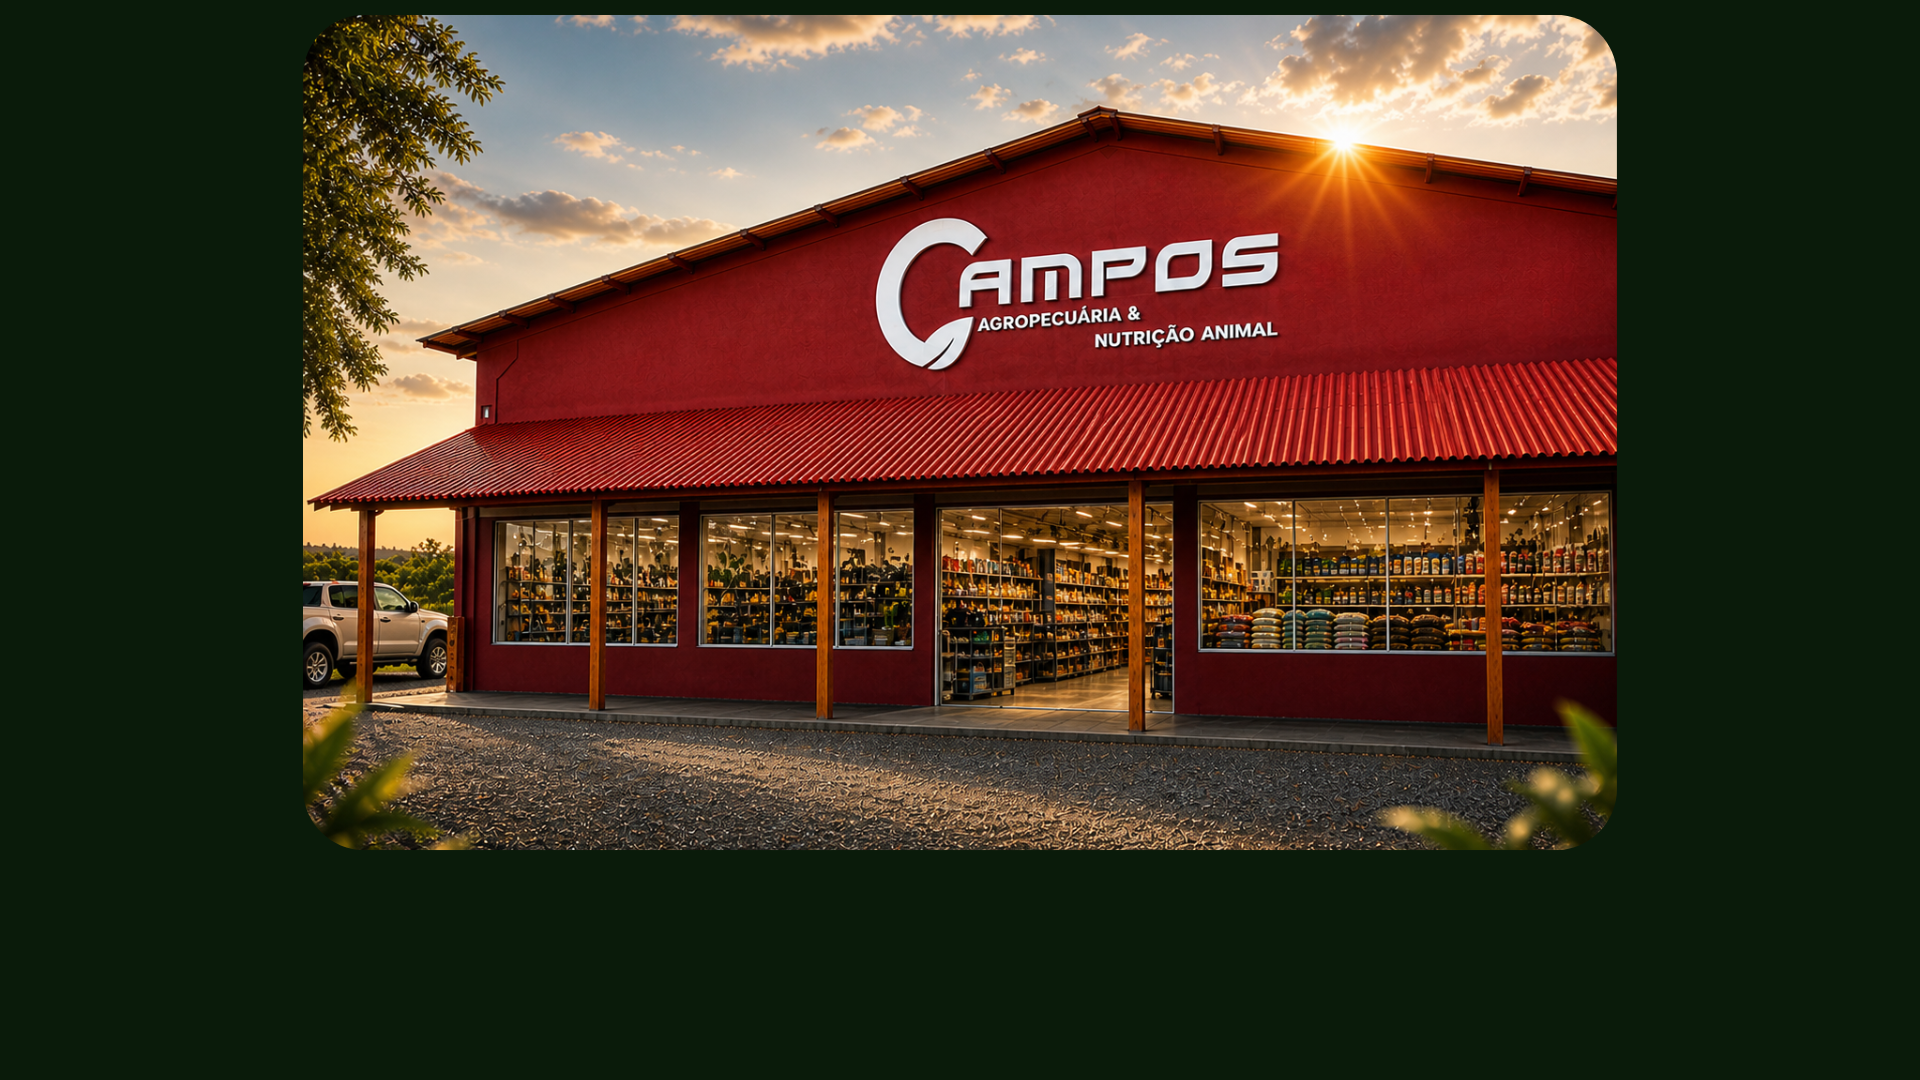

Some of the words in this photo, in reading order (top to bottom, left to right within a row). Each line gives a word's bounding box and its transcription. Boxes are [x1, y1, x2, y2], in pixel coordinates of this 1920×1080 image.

[977, 305, 1122, 332] AGROPECUÁRIA
[1127, 305, 1141, 321] &
[1094, 324, 1195, 349] NUTRIÇÃO
[1200, 322, 1279, 342] ANIMAL
